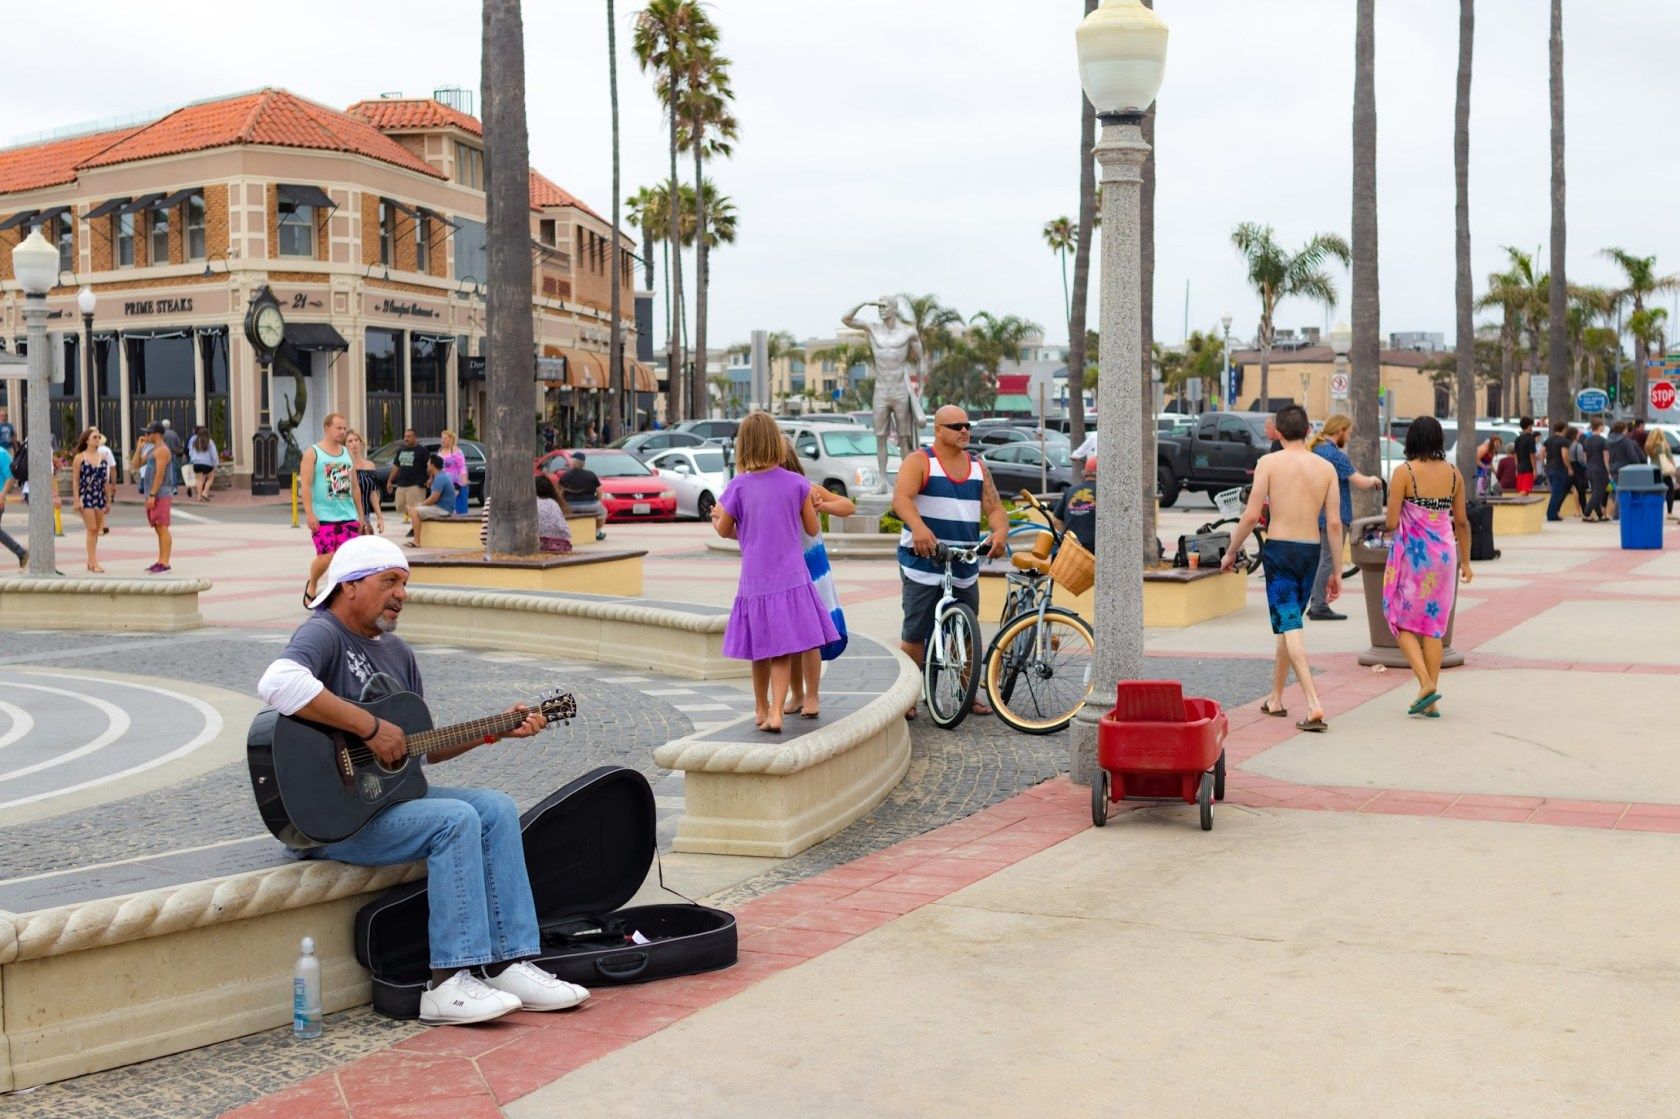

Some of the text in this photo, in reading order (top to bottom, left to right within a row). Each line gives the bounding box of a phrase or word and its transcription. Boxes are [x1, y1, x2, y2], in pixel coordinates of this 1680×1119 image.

[124, 298, 193, 315] PRIME STEAKS
[292, 293, 306, 309] 21
[469, 361, 485, 369] Dor
[1652, 388, 1675, 403] STOP
